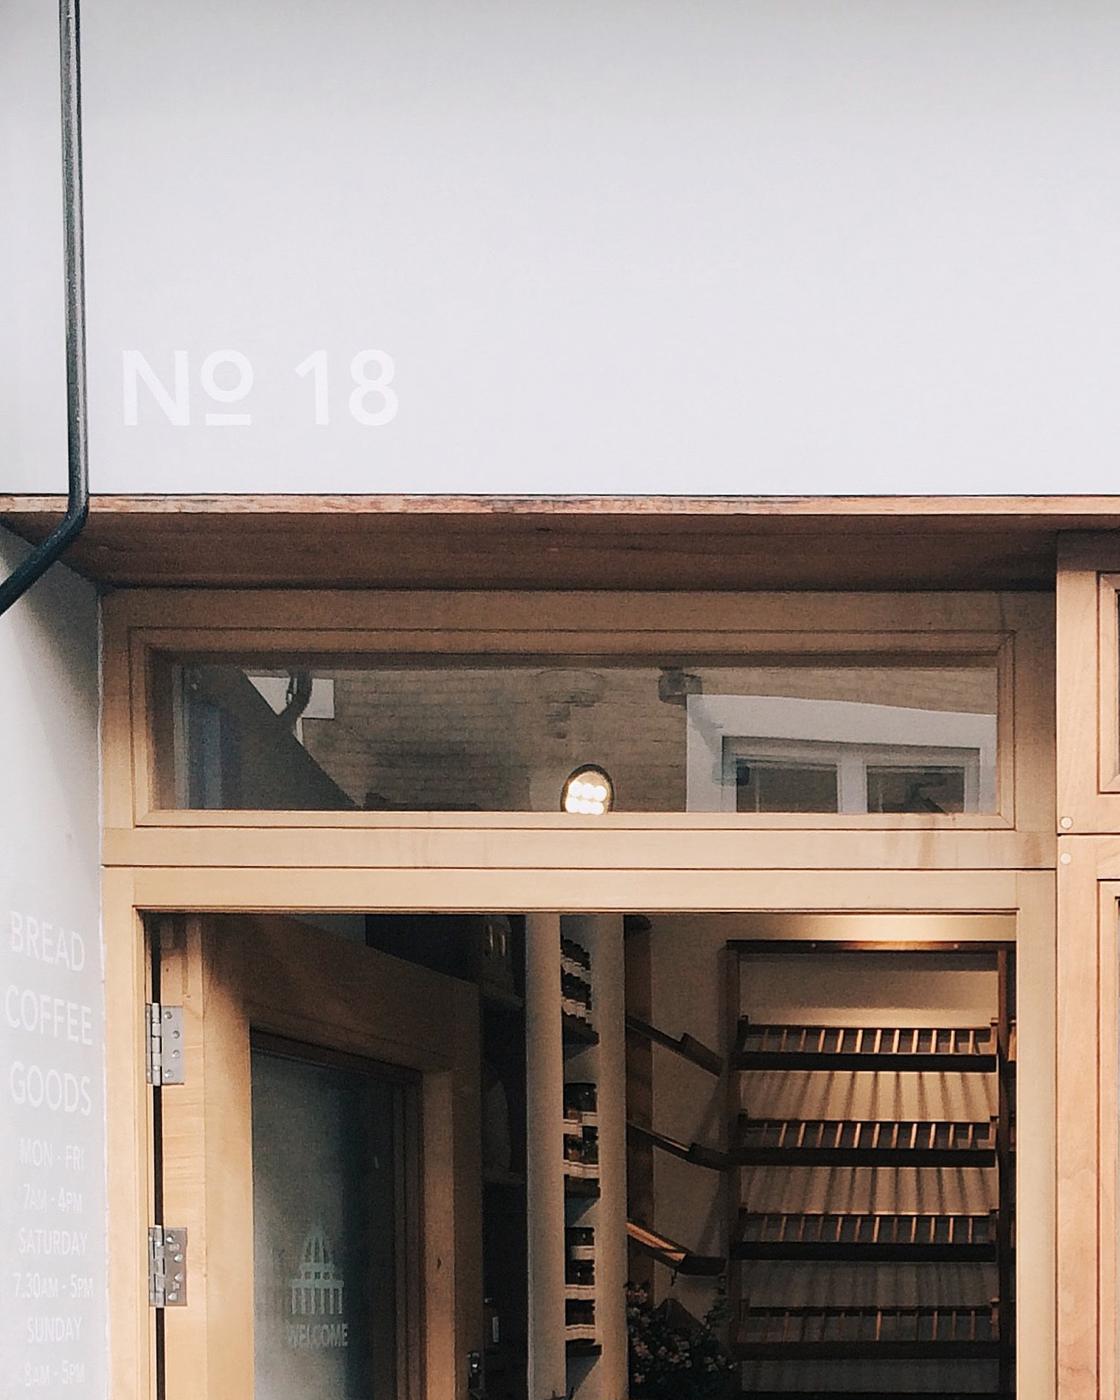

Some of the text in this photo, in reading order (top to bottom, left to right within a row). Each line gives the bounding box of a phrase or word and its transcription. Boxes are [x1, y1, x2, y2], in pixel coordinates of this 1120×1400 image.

[294, 349, 399, 426] 18
[9, 910, 85, 972] BREAD
[5, 984, 93, 1045] COFFEE
[9, 1060, 92, 1117] GOODS
[19, 1137, 54, 1168] MON
[64, 1144, 86, 1171] FRI
[18, 1227, 89, 1257] SATURDAY
[69, 1273, 95, 1299] 5PM
[26, 1315, 83, 1344] SUNDAY
[286, 1322, 349, 1348] WELCOME
